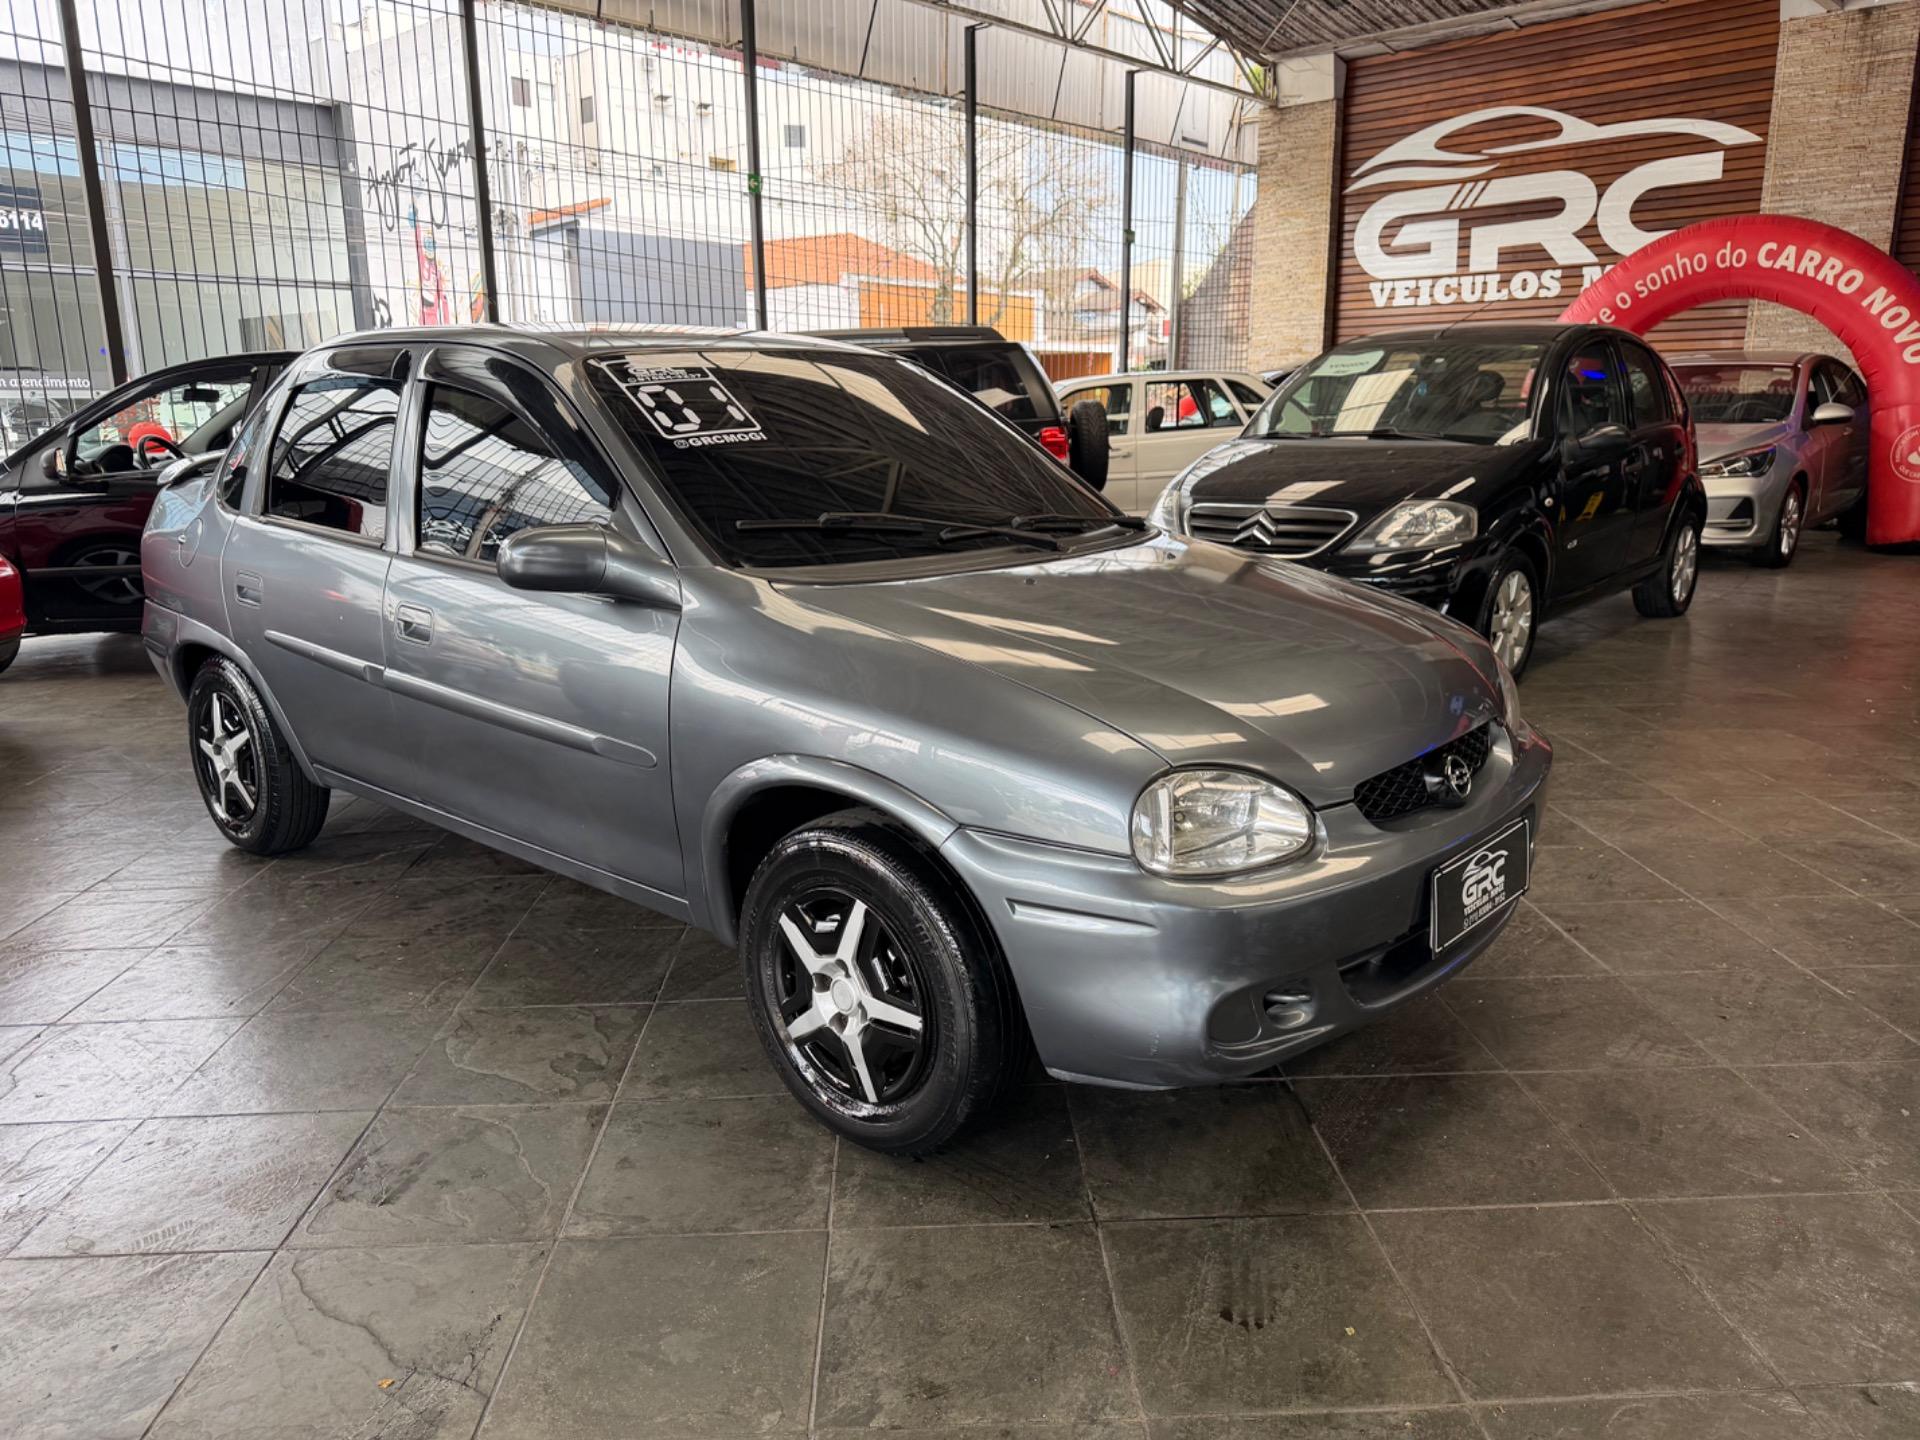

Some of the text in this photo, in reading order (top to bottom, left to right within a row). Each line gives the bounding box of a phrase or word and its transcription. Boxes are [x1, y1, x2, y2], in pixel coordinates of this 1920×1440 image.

[1354, 151, 1724, 280] GRC
[1369, 269, 1562, 307] VEICULOS
[1616, 291, 1631, 309] o
[1634, 251, 1708, 298] sonho
[1716, 241, 1748, 269] do
[1757, 241, 1864, 295] CARRO
[9, 376, 90, 388] aendimento
[1463, 857, 1505, 906] GRC
